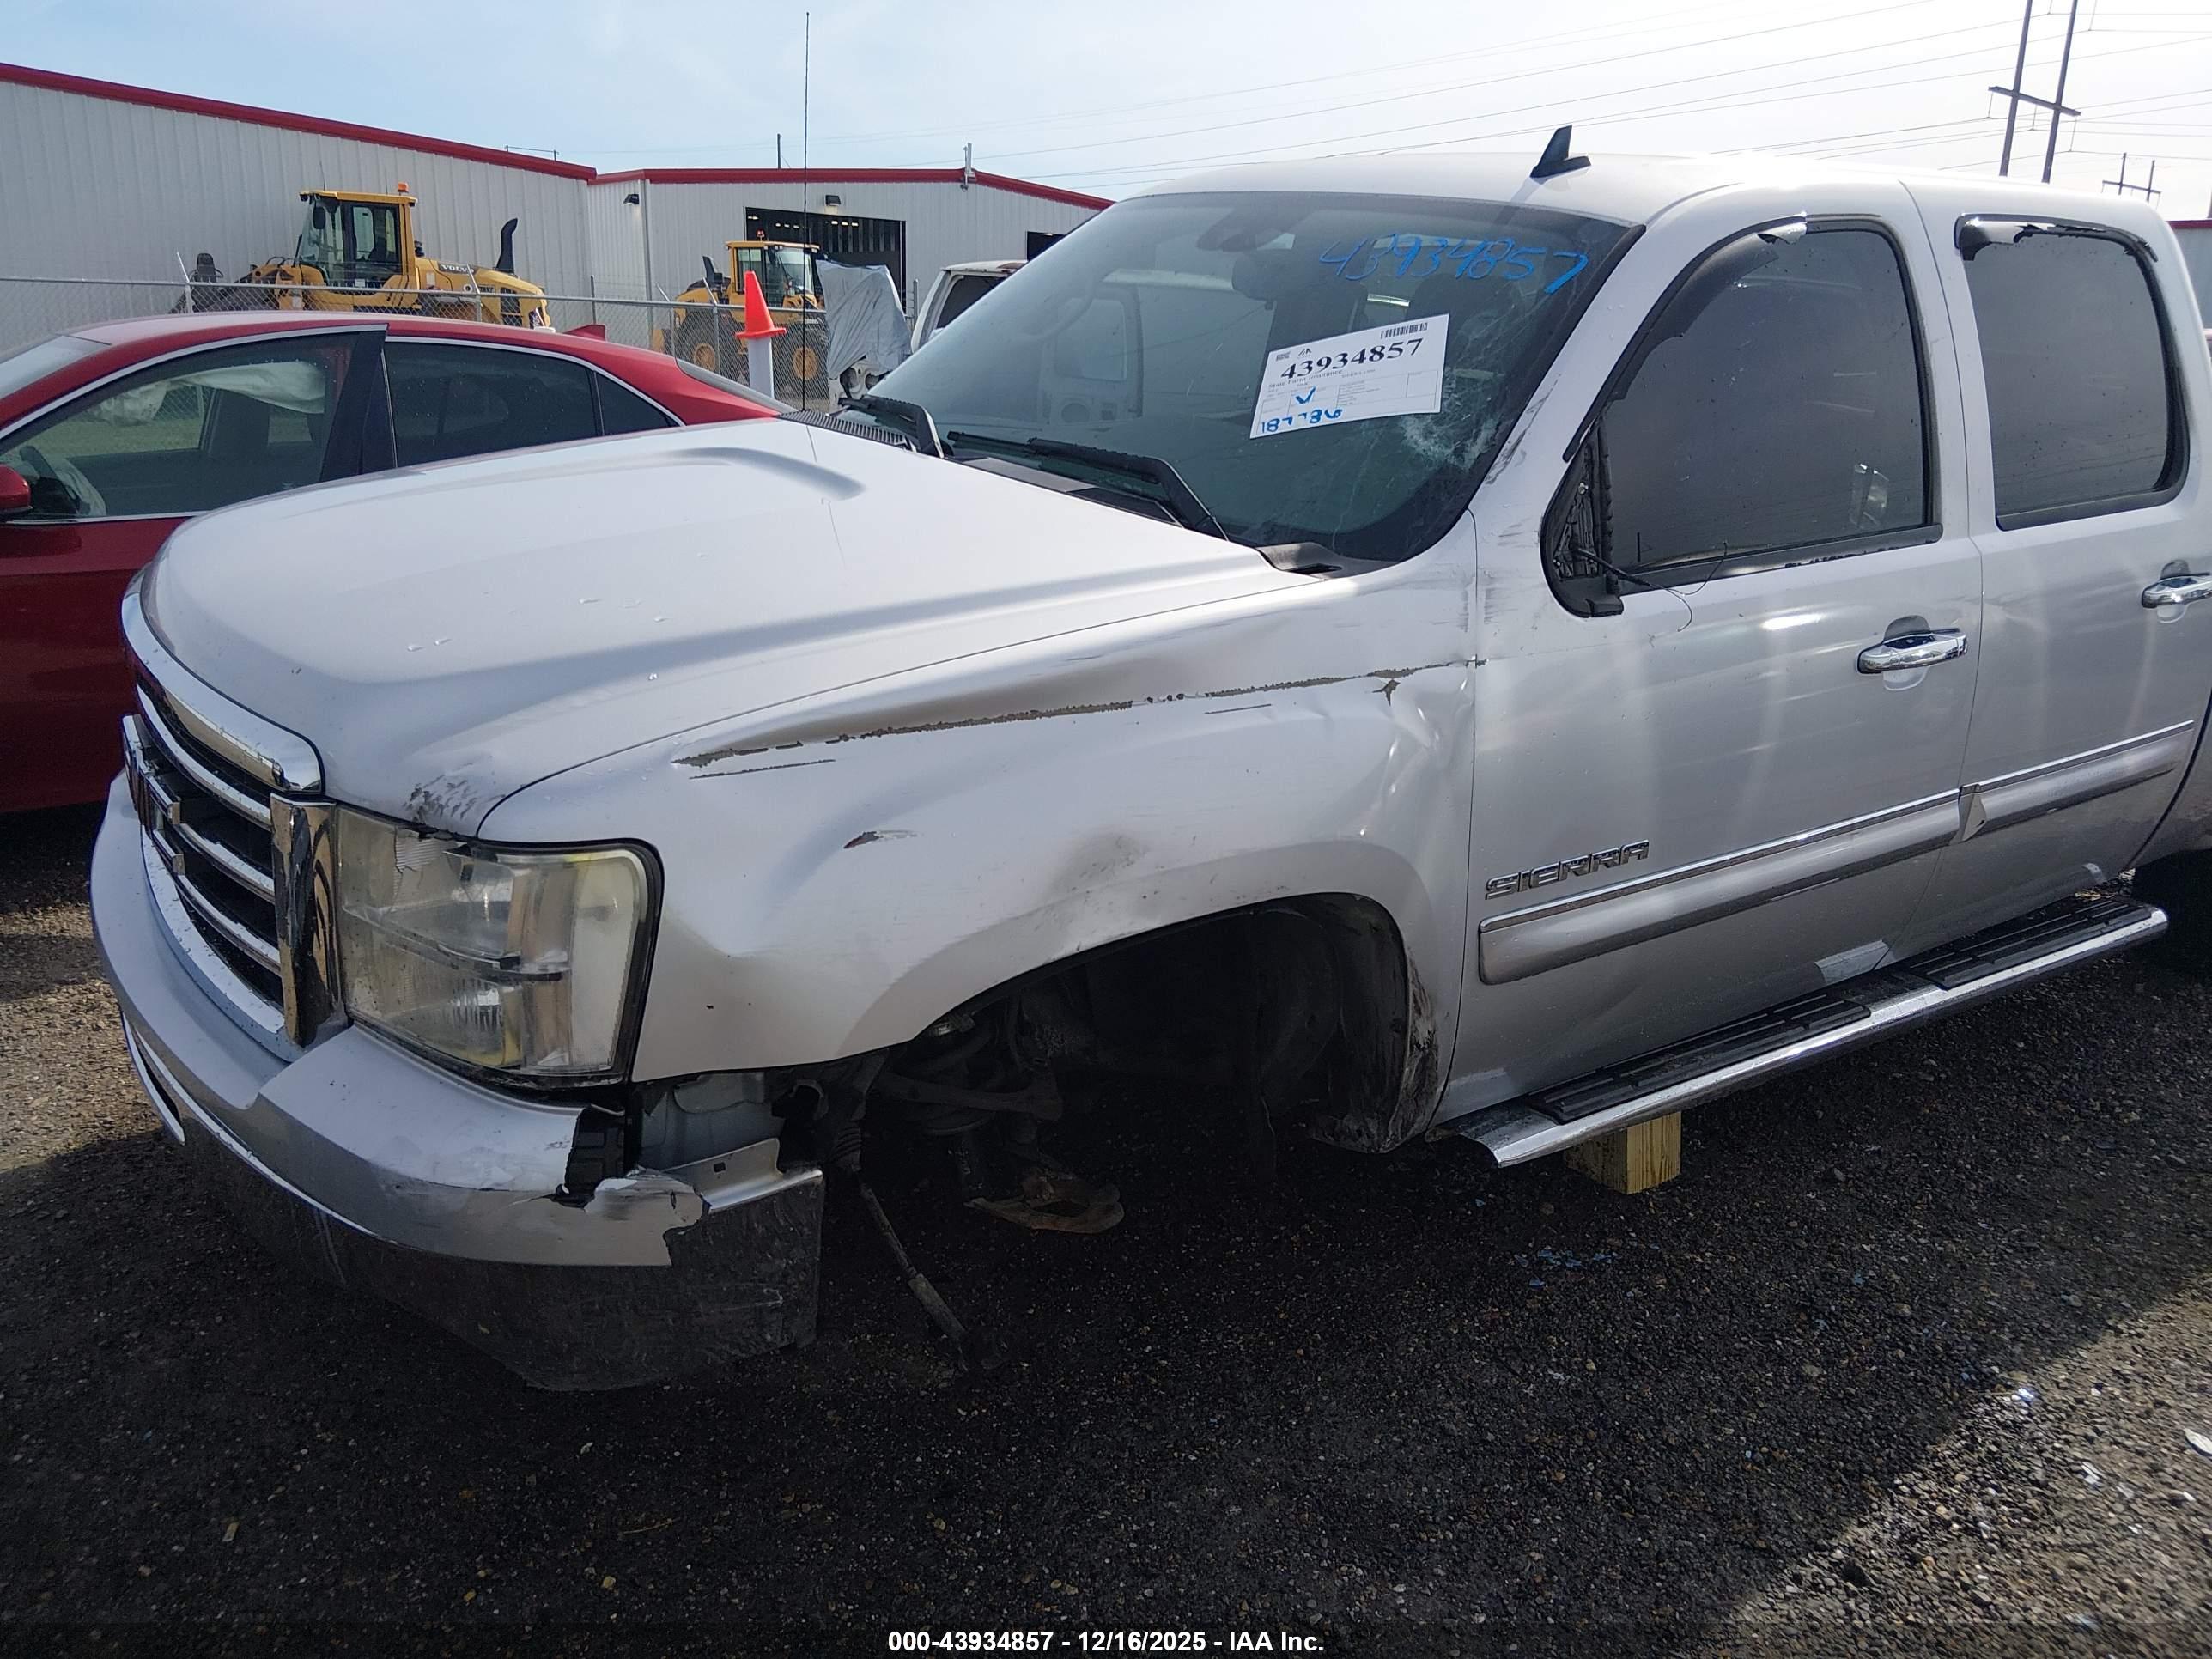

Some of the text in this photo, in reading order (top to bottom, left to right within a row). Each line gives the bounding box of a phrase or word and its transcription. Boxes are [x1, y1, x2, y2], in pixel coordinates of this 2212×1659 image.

[1319, 233, 1589, 295] 43934857
[1281, 337, 1423, 380] 43934857
[1486, 839, 1650, 900] SIERRA
